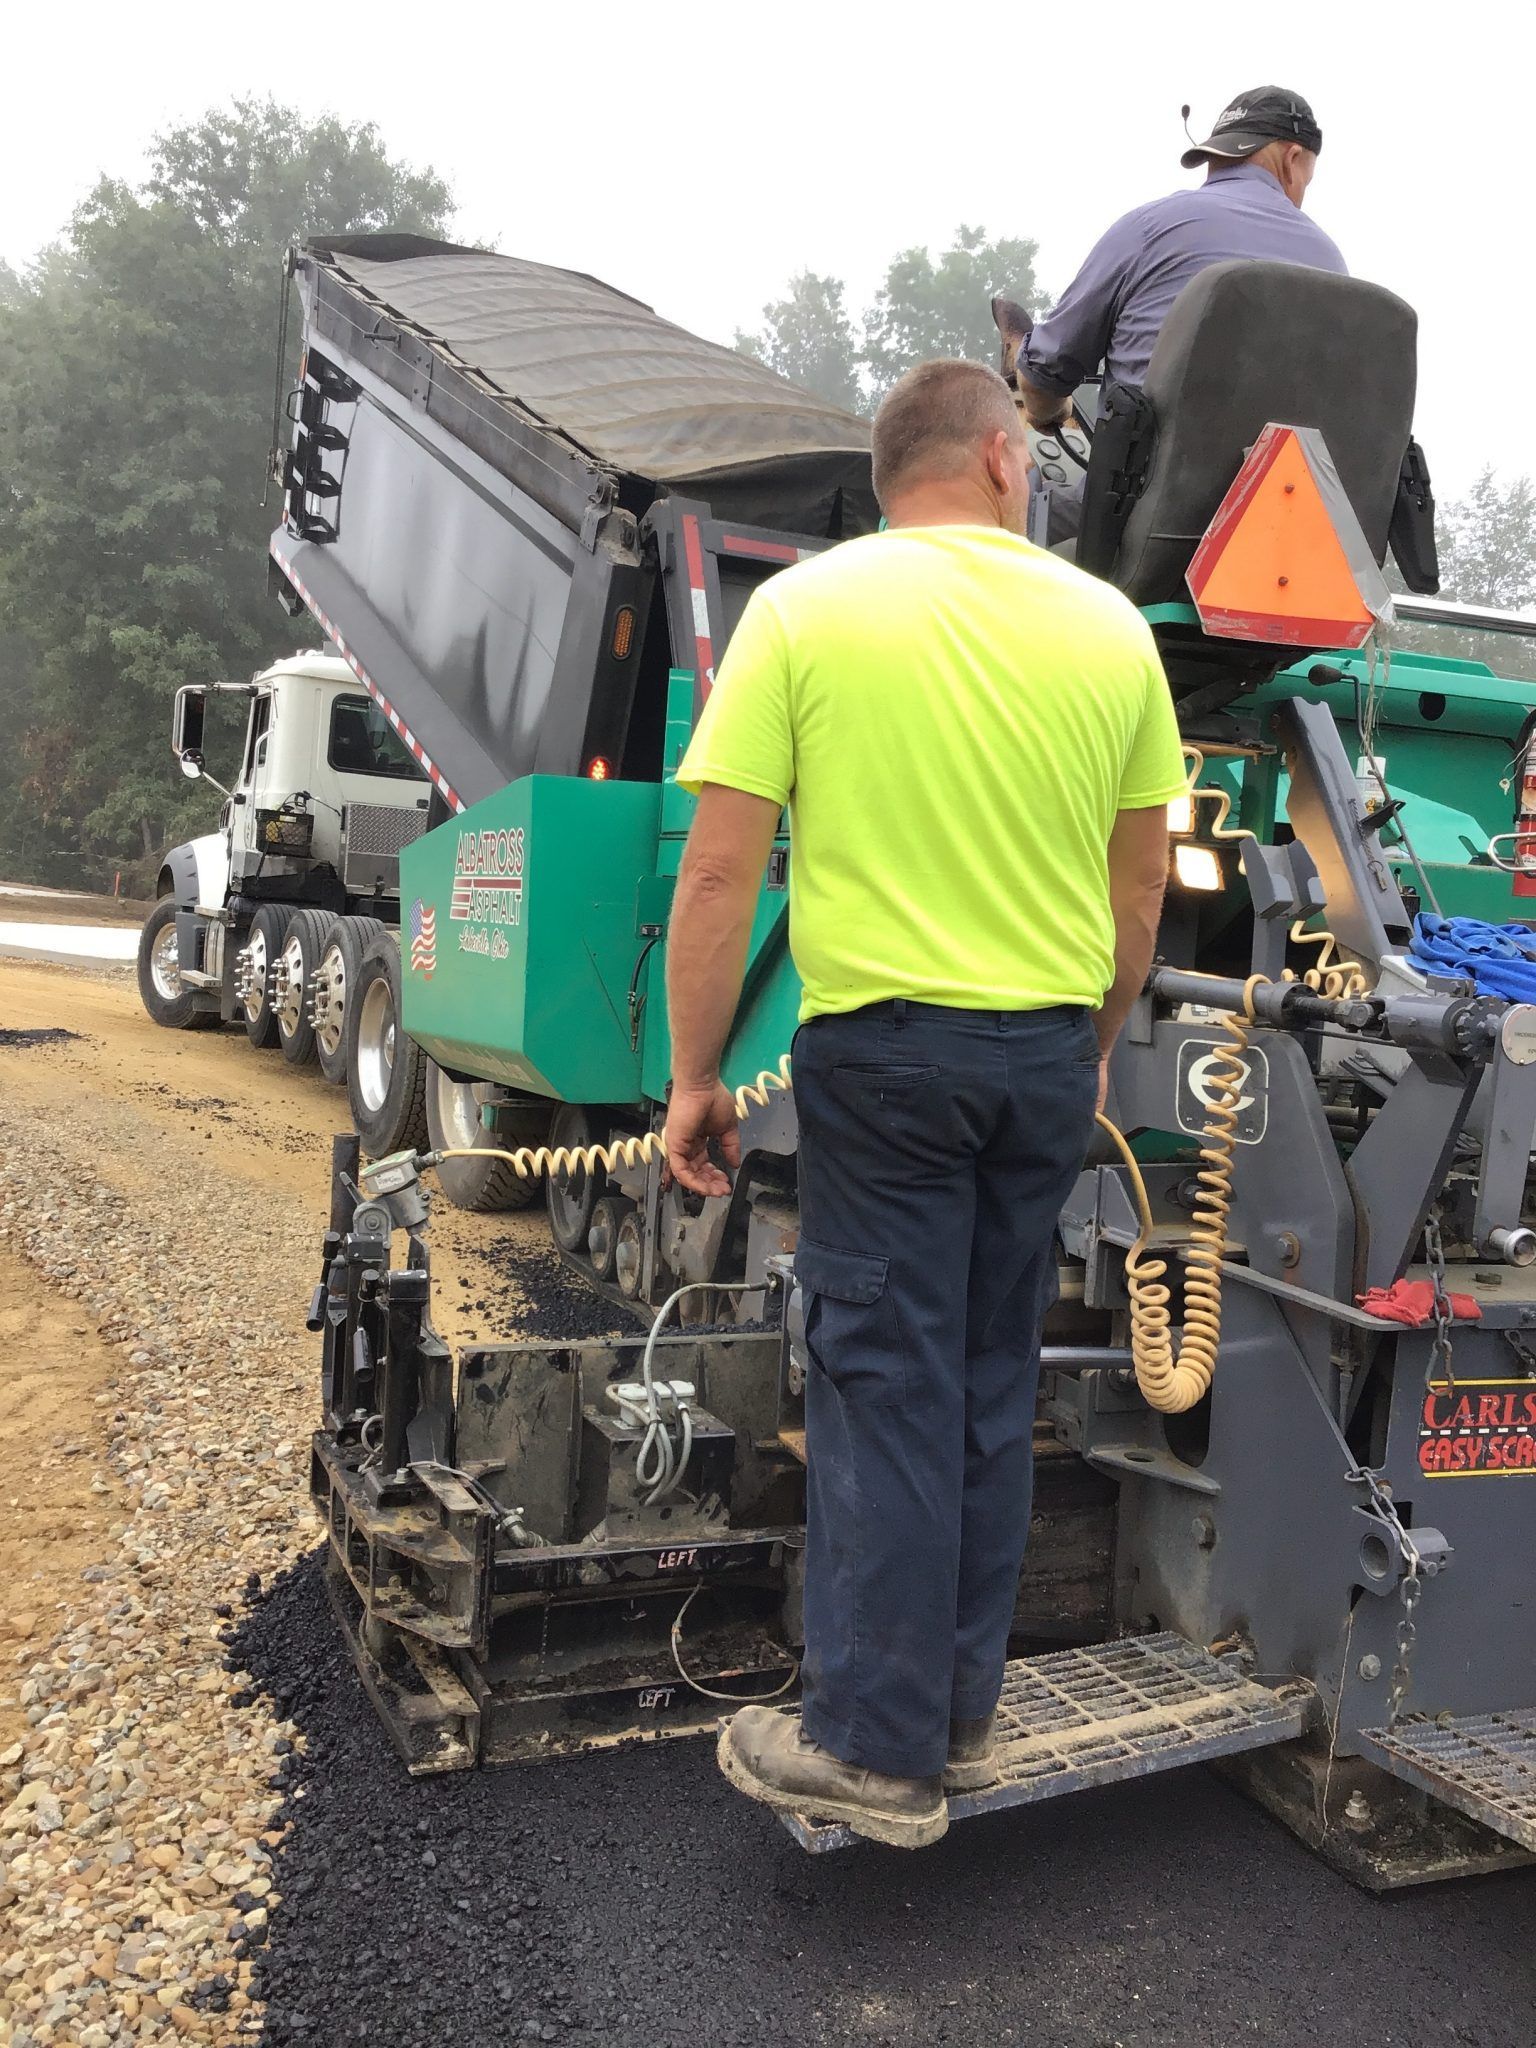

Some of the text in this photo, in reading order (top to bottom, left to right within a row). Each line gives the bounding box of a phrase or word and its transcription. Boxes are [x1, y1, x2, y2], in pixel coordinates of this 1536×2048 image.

[455, 827, 524, 875] ALBATROSS
[468, 880, 522, 925] ASPHALT
[1419, 1434, 1536, 1470] EASY SCR
[658, 1548, 698, 1569] LEFT
[638, 1687, 676, 1709] LEFT
